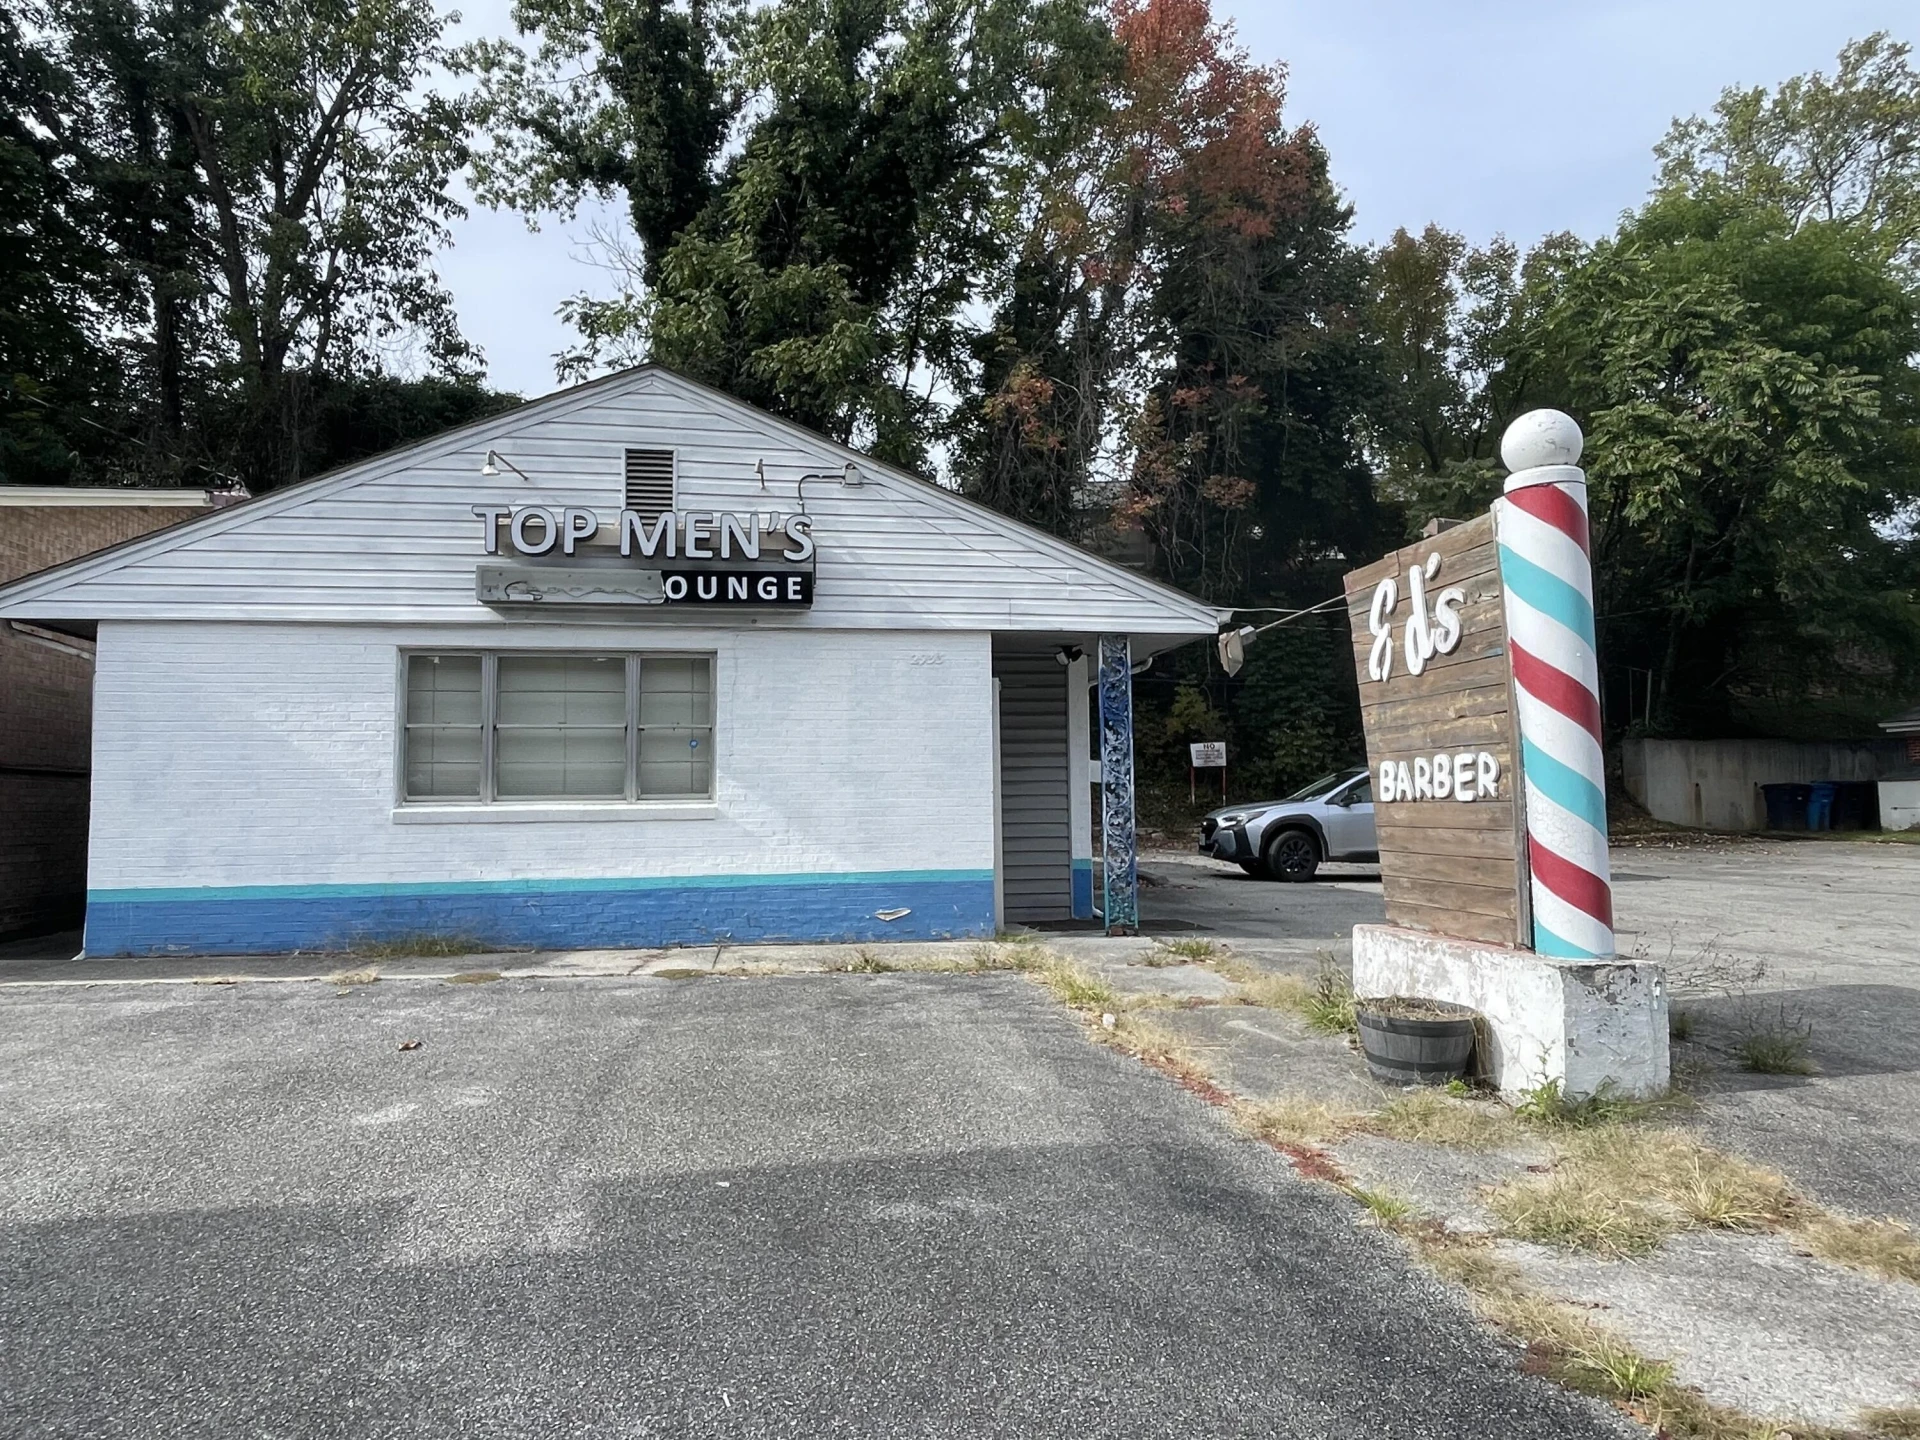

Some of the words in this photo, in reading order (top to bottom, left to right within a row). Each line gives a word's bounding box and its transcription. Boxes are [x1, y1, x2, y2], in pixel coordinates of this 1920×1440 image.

[472, 505, 598, 556] TOP
[620, 510, 816, 562] MEN'S
[1379, 752, 1500, 803] BARBER
